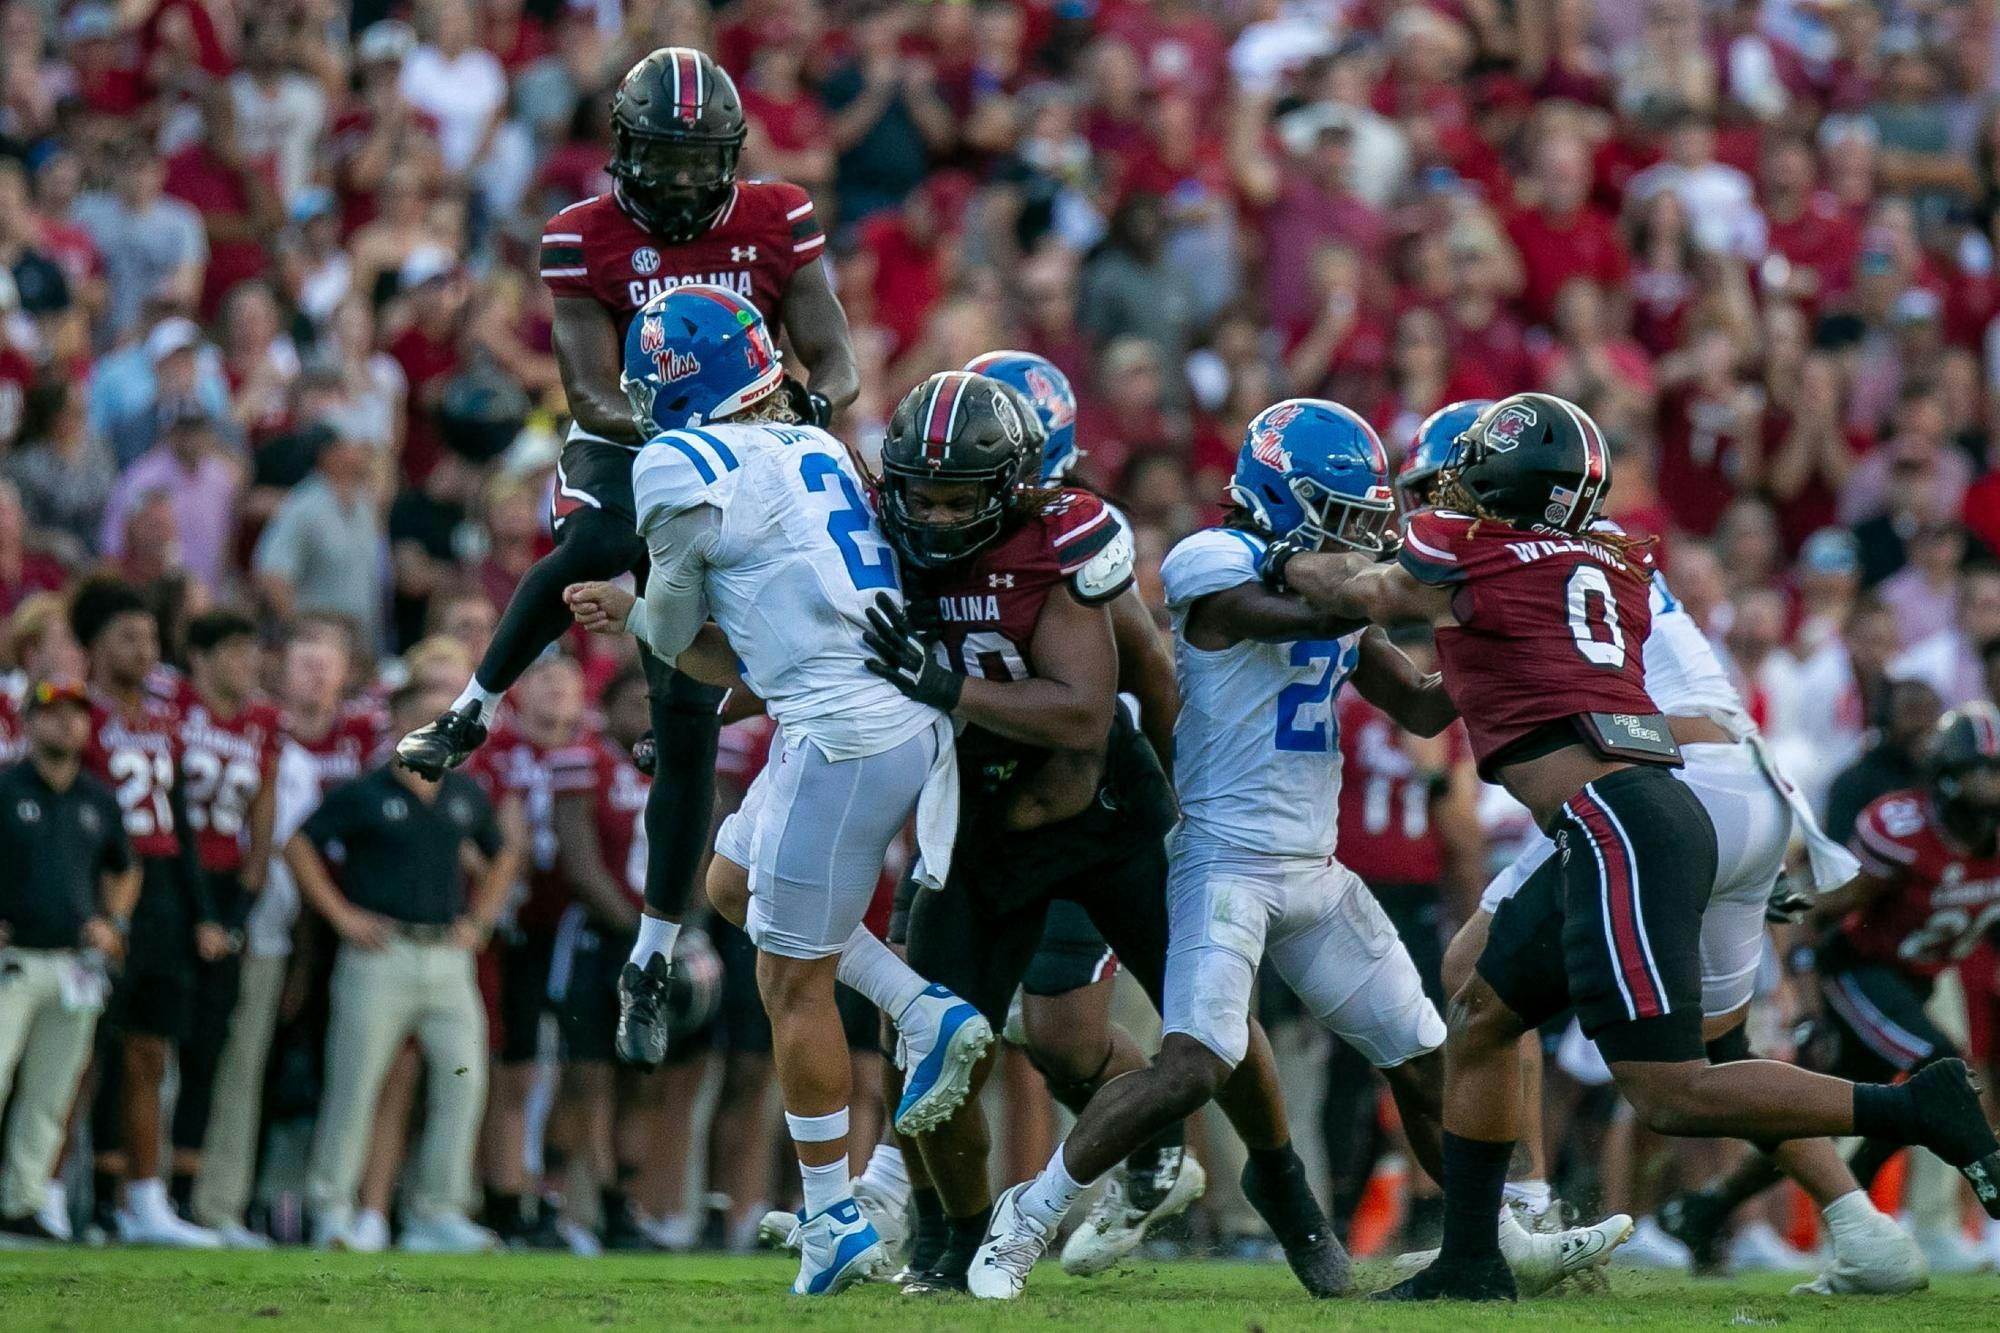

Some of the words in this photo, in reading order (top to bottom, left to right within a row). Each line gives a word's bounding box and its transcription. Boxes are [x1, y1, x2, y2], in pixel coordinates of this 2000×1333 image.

[633, 247, 659, 275] SEC
[641, 315, 665, 354] Ole
[652, 347, 701, 385] Miss
[1251, 427, 1286, 474] Miss
[799, 452, 899, 592] 2
[1567, 564, 1626, 669] 0
[1627, 725, 1661, 742] GEAR
